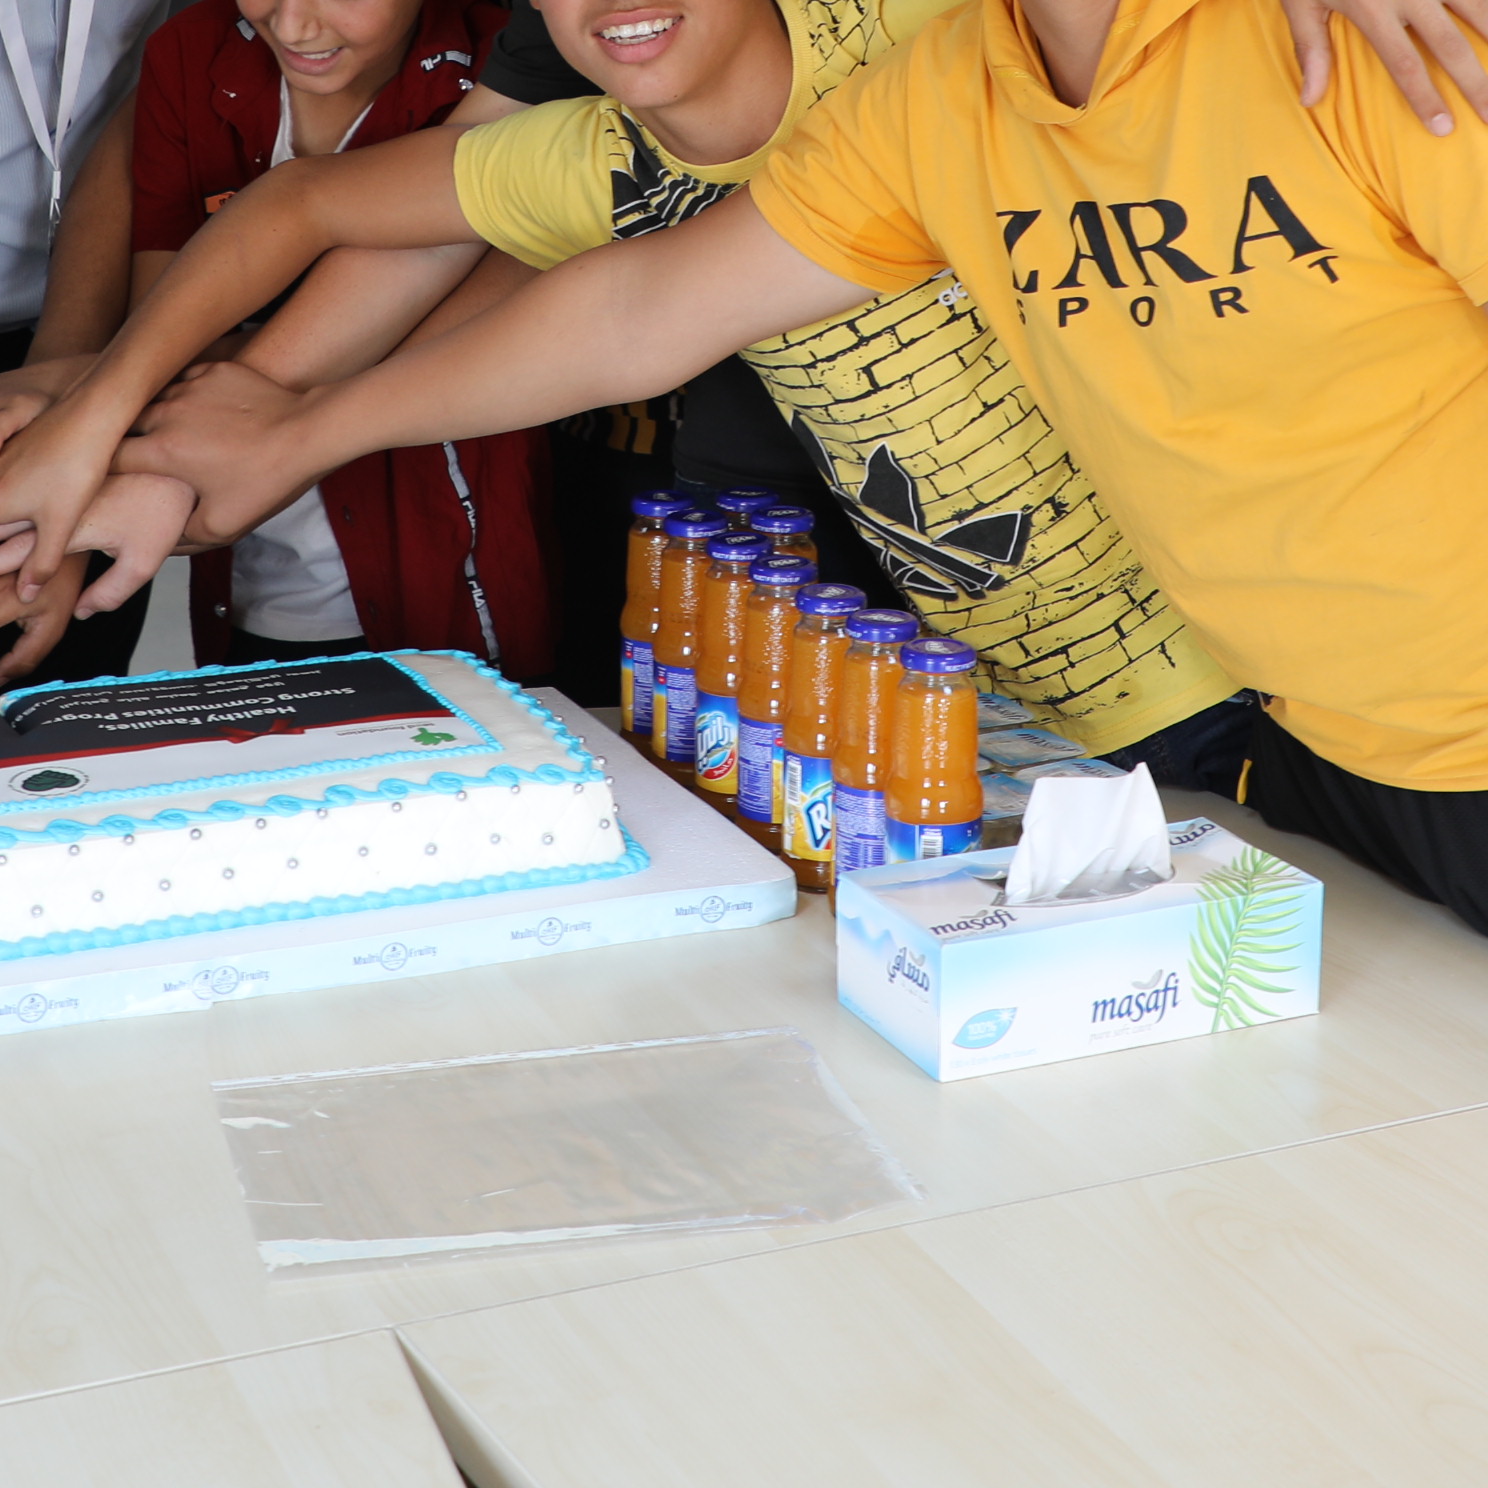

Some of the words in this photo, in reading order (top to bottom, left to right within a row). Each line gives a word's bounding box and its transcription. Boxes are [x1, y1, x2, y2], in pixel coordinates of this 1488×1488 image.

[996, 175, 1334, 294] ZARA
[281, 686, 357, 702] Strong
[122, 696, 275, 720] Communities
[211, 705, 297, 724] Healthy
[97, 714, 203, 732] Families,
[929, 908, 1018, 936] masafi
[1091, 971, 1181, 1025] masafi
